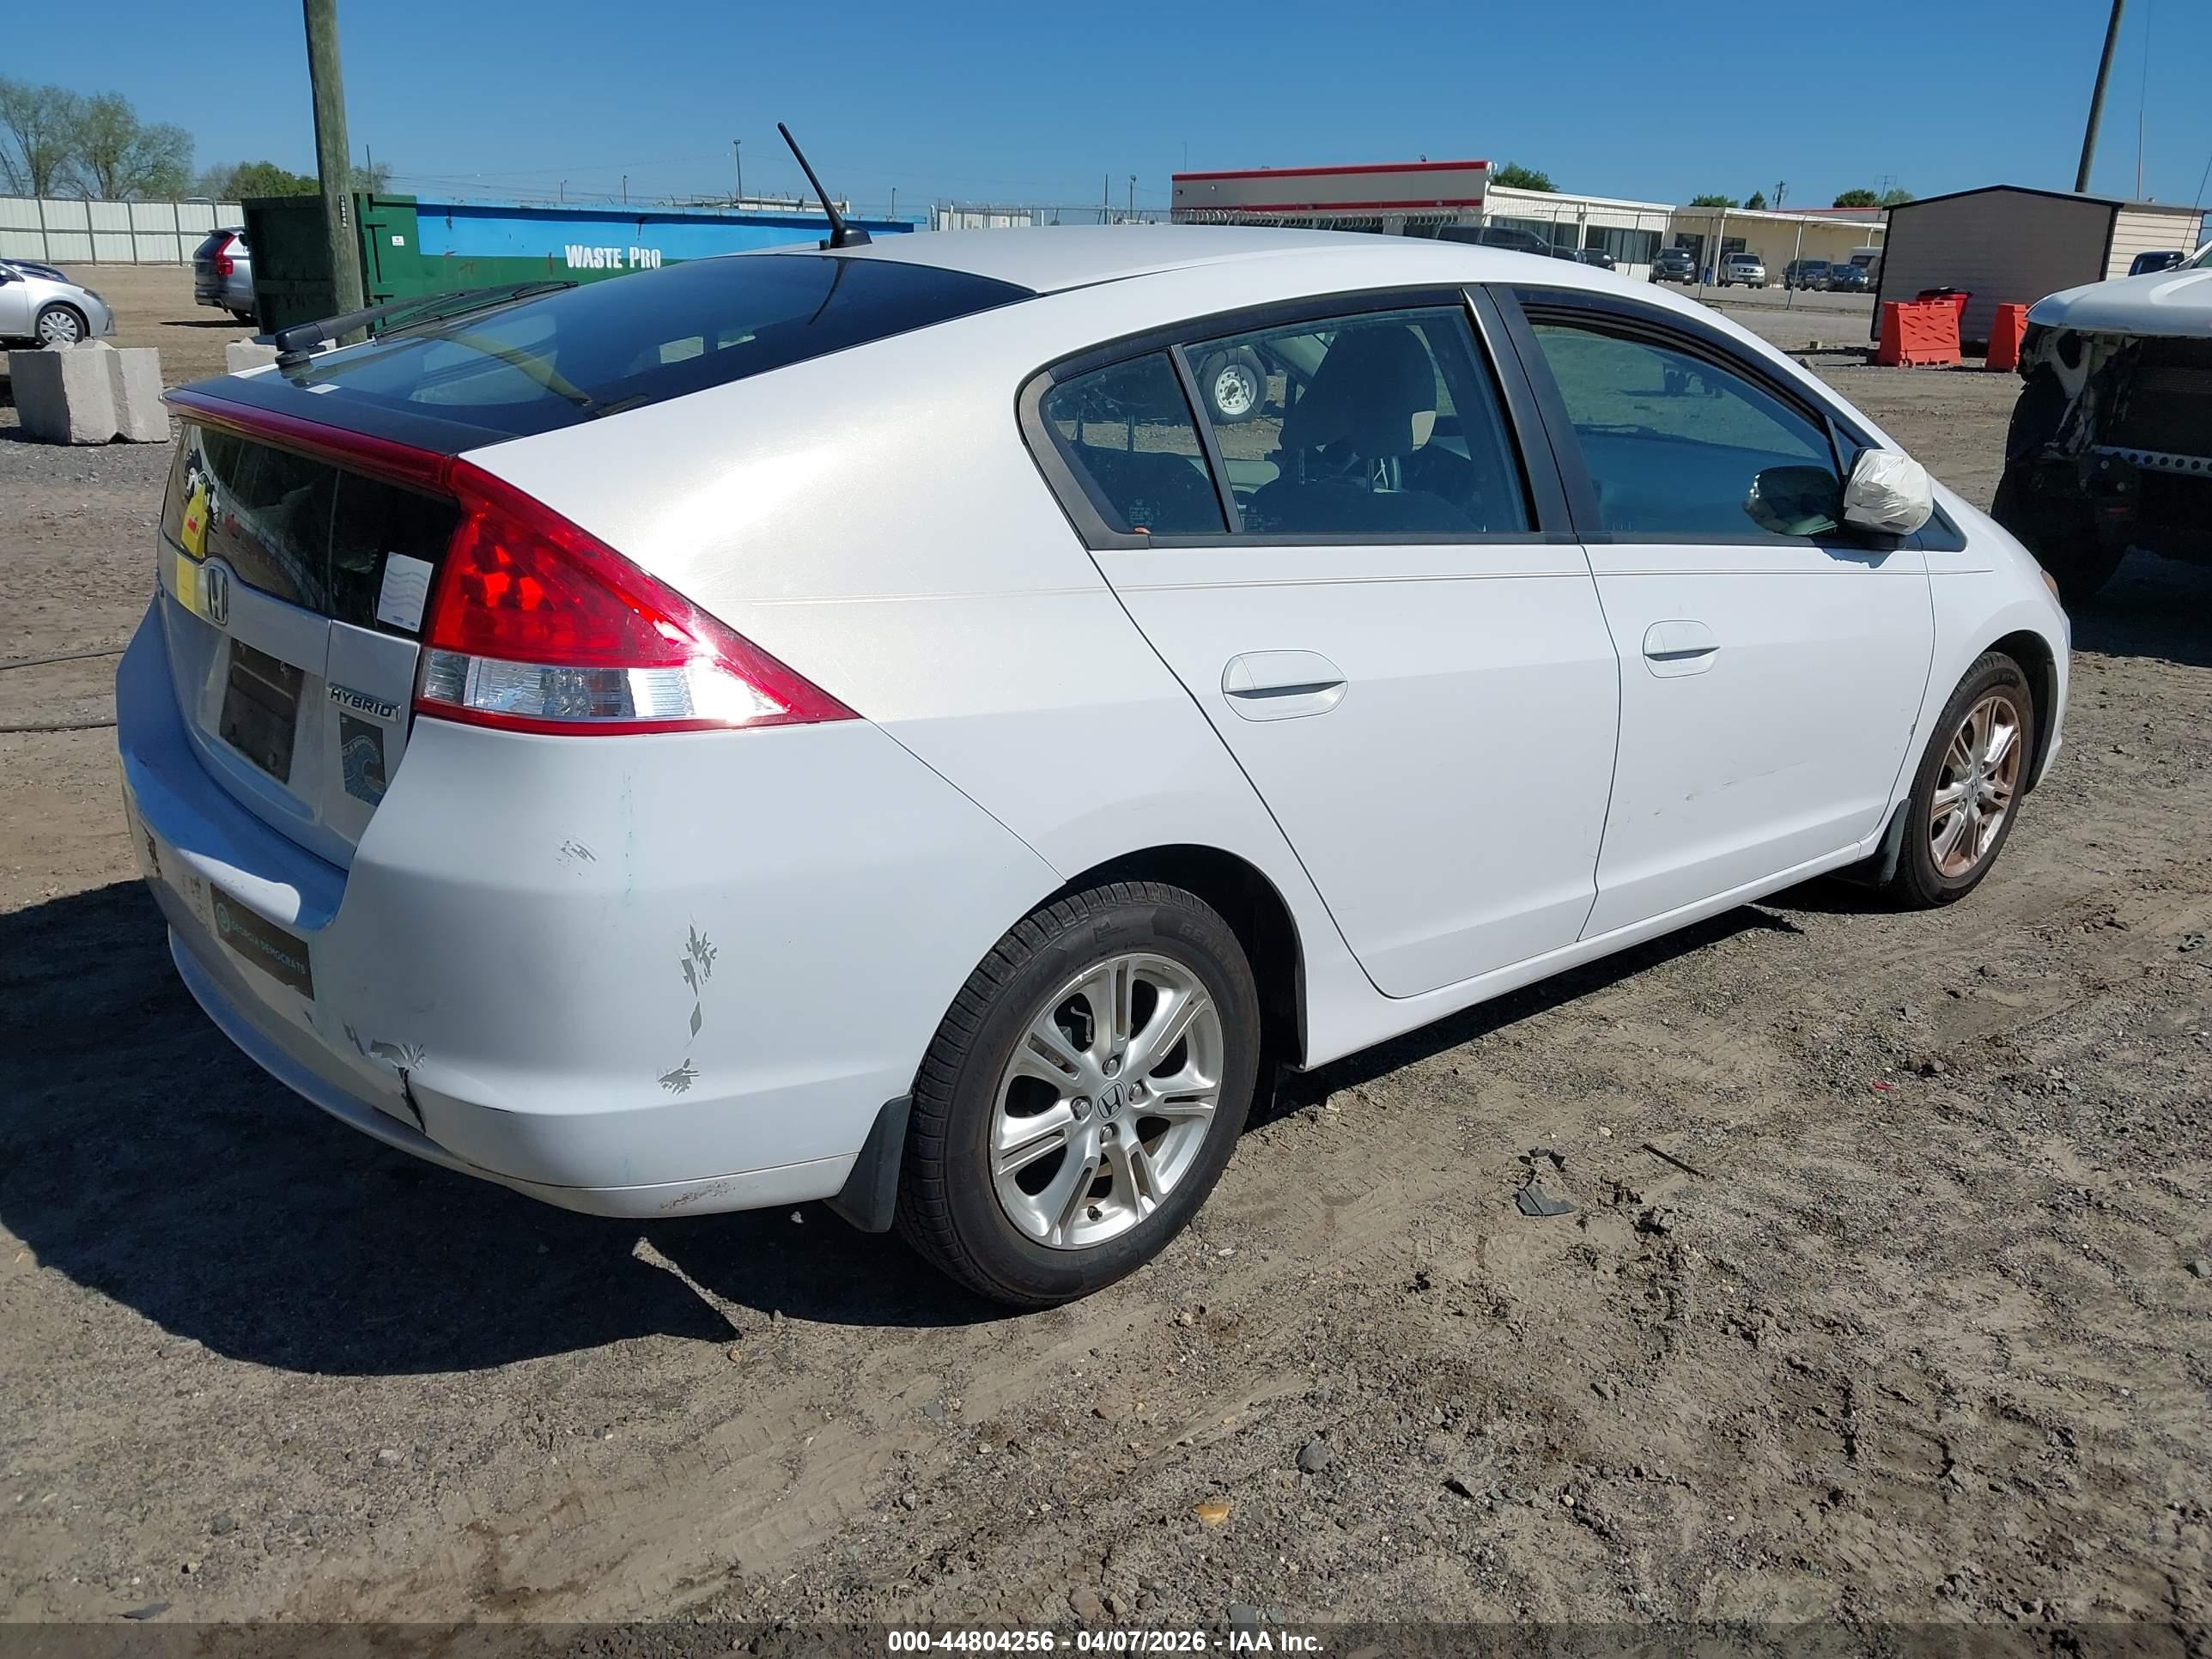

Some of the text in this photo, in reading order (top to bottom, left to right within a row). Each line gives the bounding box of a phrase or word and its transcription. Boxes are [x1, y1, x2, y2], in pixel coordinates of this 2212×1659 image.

[564, 245, 661, 270] WASTE PRO
[330, 688, 392, 718] HYBRID
[259, 939, 307, 975] DEMOCRATS
